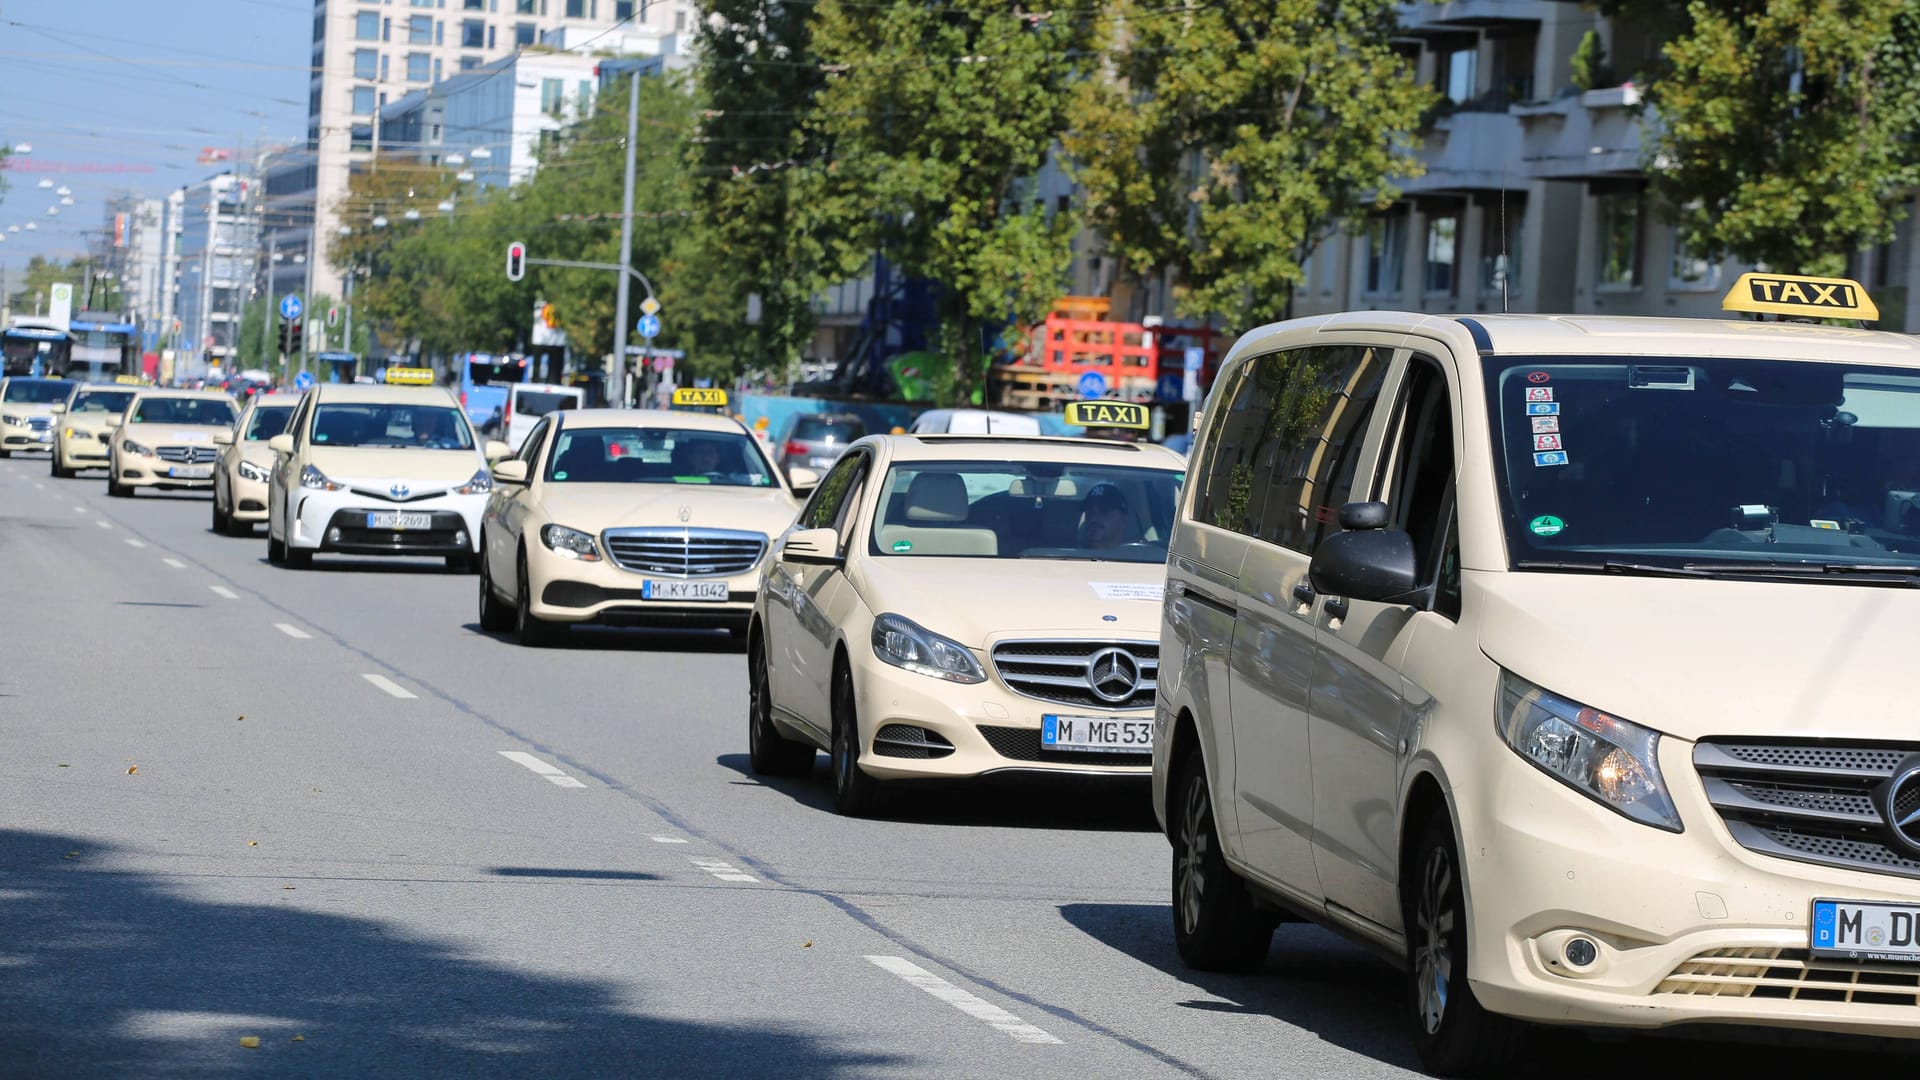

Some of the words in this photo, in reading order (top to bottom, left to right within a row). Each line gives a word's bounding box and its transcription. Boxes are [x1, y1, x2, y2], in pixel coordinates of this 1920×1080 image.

[1752, 279, 1857, 307] TAXI
[682, 391, 718, 401] TAXI
[1081, 405, 1137, 423] TAXI
[652, 583, 661, 597] M
[670, 583, 689, 597] KY
[692, 584, 726, 597] 1042
[1047, 732, 1054, 740] D
[1058, 720, 1073, 742] M
[1088, 721, 1118, 744] MG
[1123, 722, 1154, 744] 53
[1820, 930, 1829, 940] D
[1838, 909, 1862, 944] M
[1889, 911, 1920, 947] D
